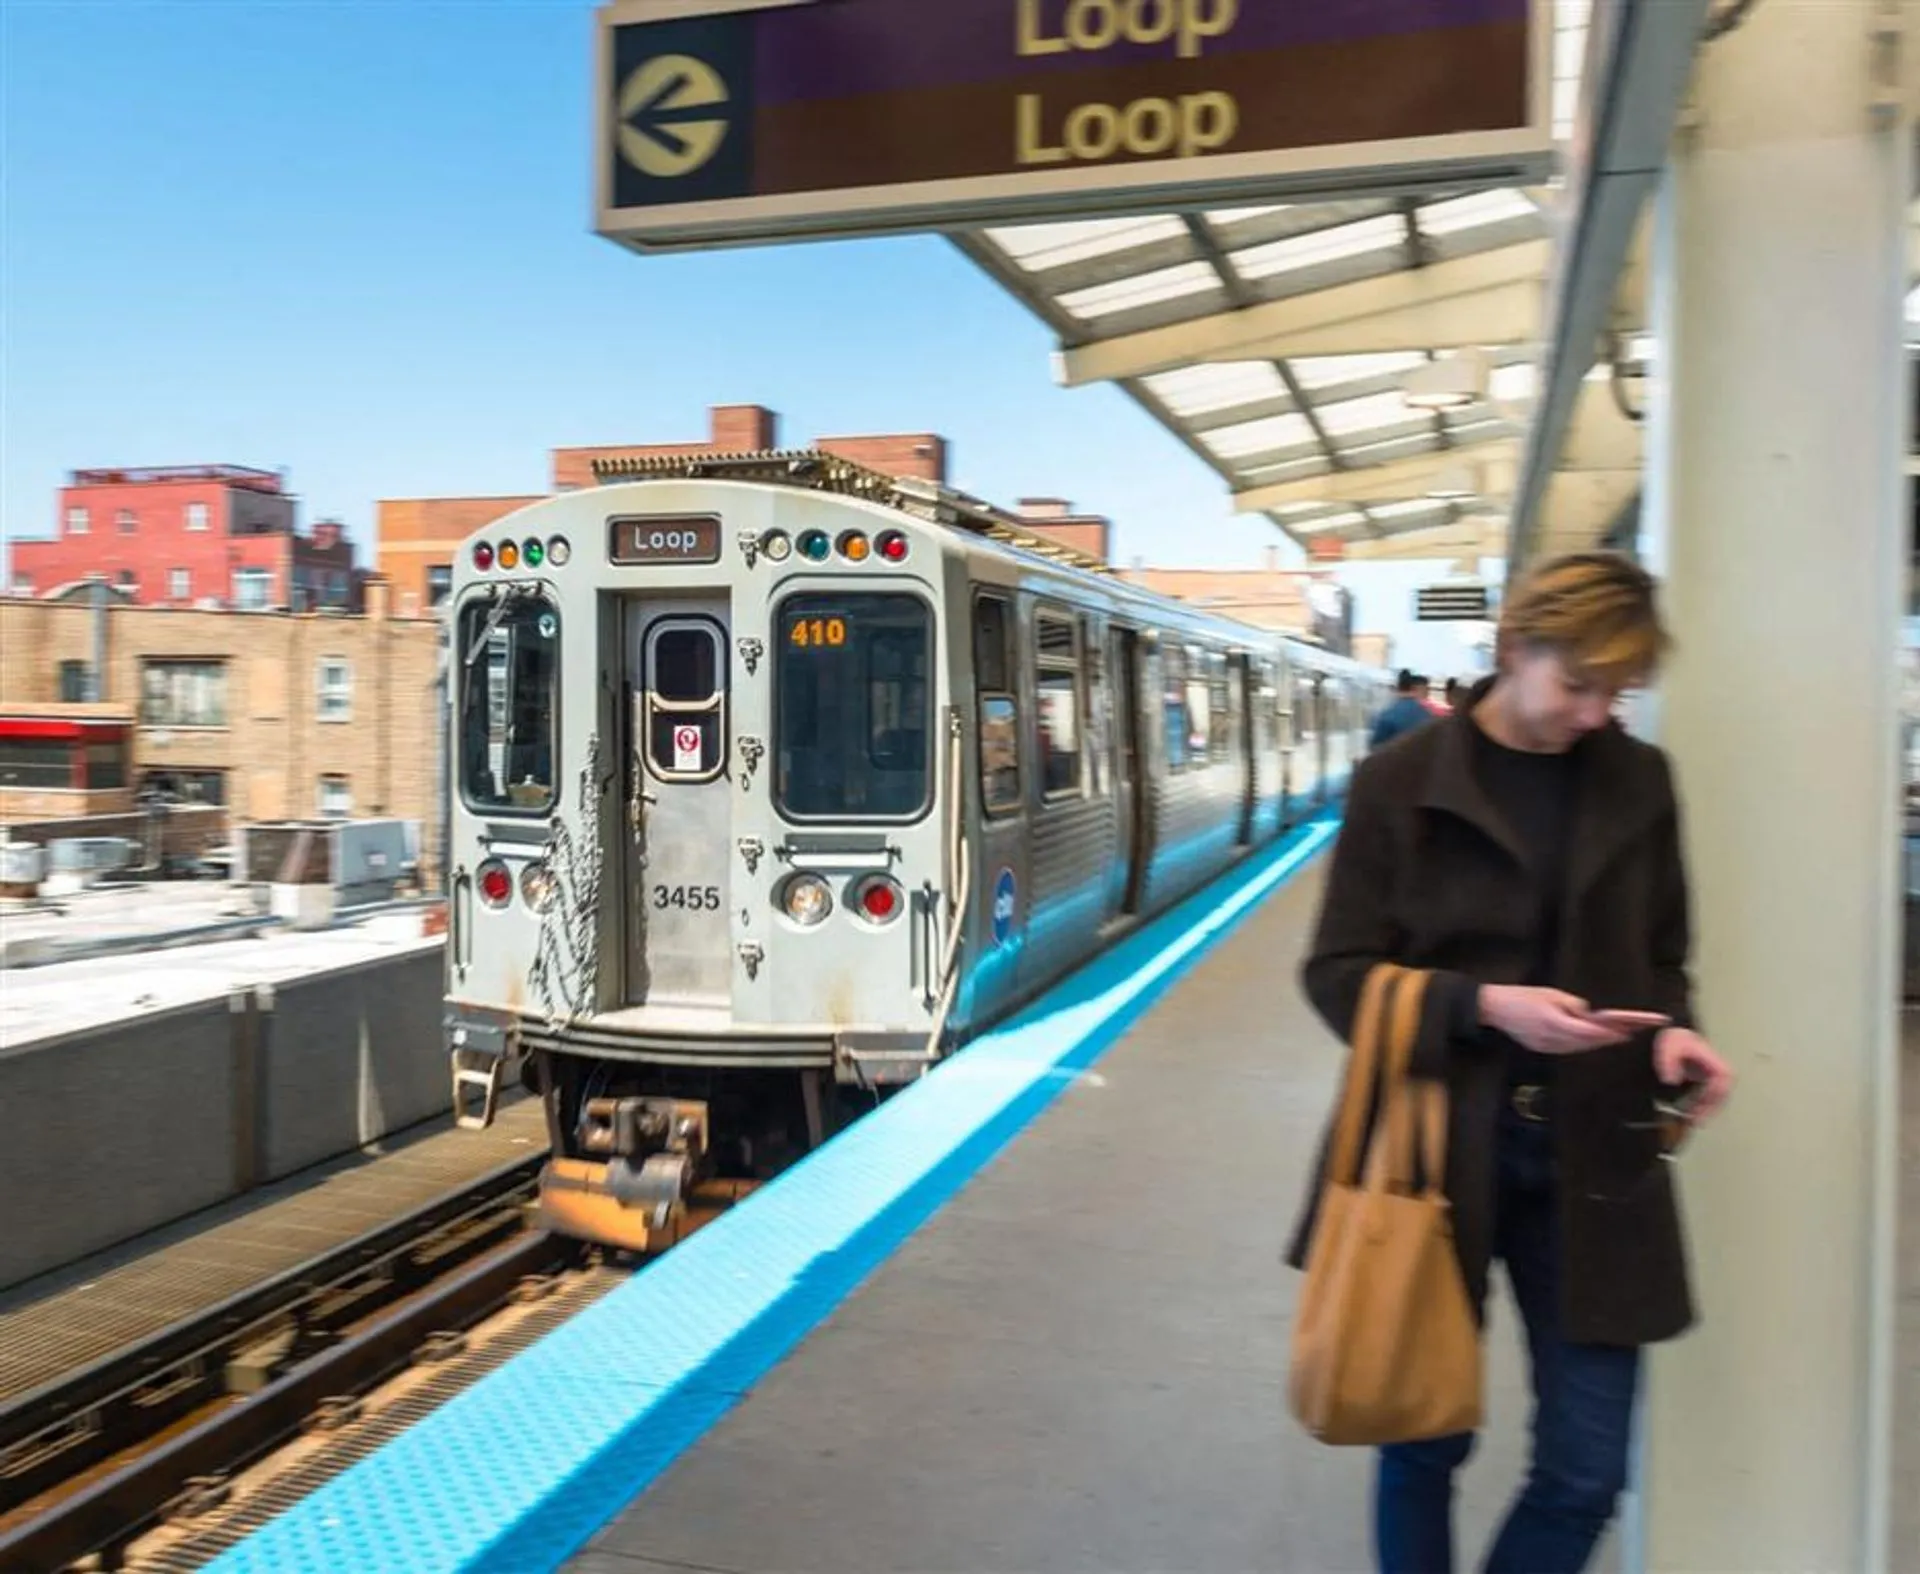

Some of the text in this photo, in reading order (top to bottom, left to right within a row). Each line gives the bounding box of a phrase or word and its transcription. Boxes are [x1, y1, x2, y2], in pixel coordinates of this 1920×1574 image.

[1017, 0, 1238, 57] Loop
[1016, 91, 1238, 163] Loop
[634, 525, 697, 554] Loop
[790, 619, 845, 646] 410
[653, 884, 720, 911] 3455
